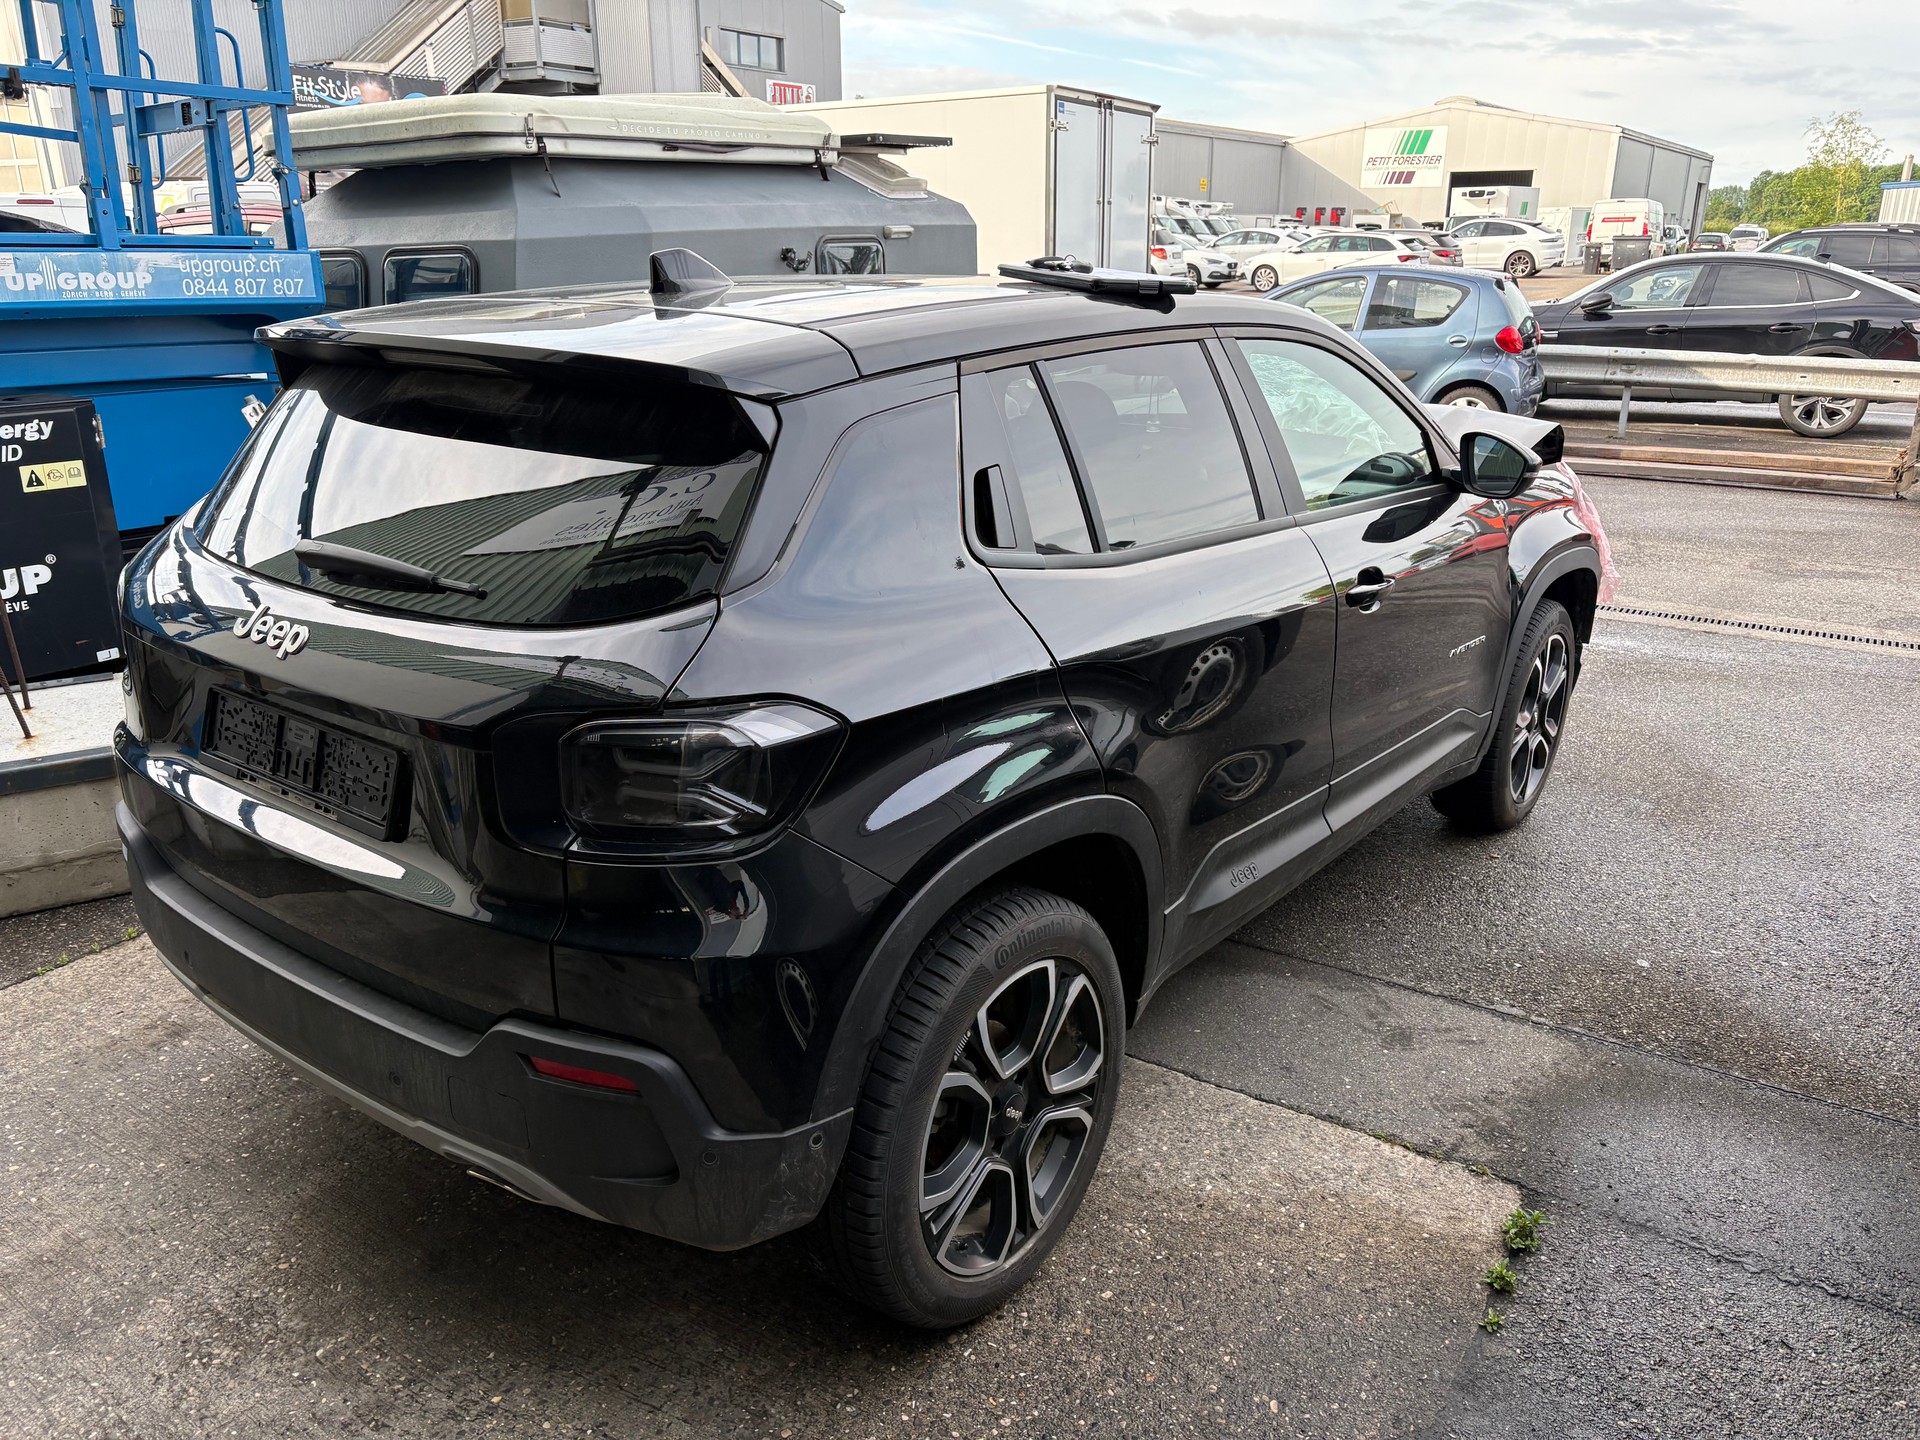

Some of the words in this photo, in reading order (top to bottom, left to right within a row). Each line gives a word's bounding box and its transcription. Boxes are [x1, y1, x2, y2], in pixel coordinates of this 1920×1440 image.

[292, 74, 362, 103] Fit-Style
[295, 94, 319, 103] Fitness
[622, 124, 661, 134] DECIDE
[666, 127, 679, 135] TU
[684, 128, 721, 137] PROPIO
[725, 131, 761, 140] CAMINO
[1366, 156, 1392, 167] PETIT
[1392, 155, 1443, 166] FORESTIER
[180, 255, 281, 278] upgroup.ch
[57, 271, 153, 290] GROUP
[182, 278, 229, 296] 0844
[234, 278, 267, 295] 807
[273, 278, 304, 295] 807
[62, 289, 88, 299] ZÜRICH
[95, 289, 114, 298] BERN
[120, 289, 147, 298] GENÈVE
[1, 444, 23, 463] ID
[233, 604, 312, 660] Jeep
[1230, 861, 1259, 889] Jeep
[993, 917, 1067, 971] Continental
